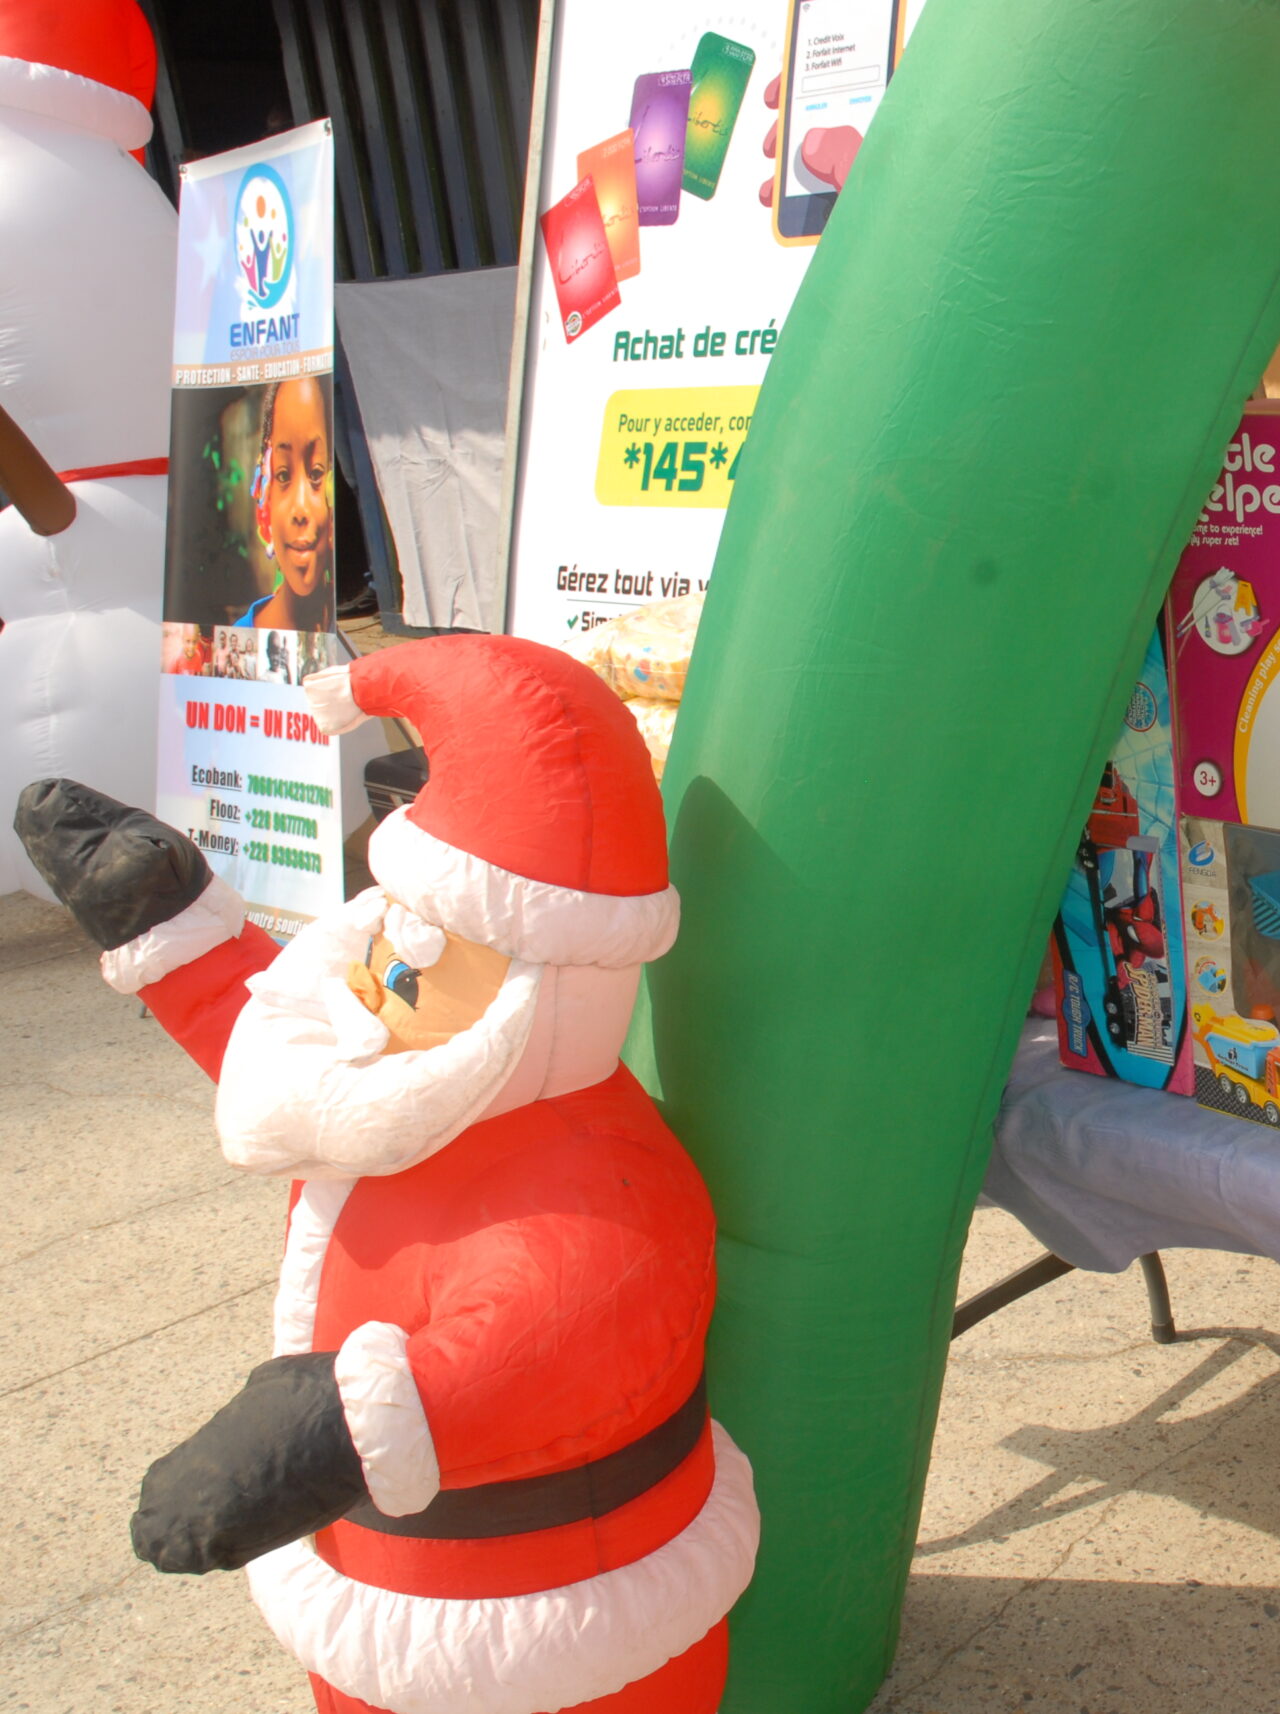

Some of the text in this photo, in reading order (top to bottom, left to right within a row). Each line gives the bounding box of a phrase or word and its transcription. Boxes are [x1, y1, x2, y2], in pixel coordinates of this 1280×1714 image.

[230, 313, 299, 347] ENFANT
[613, 328, 685, 361] Achat
[693, 326, 726, 359] de
[176, 368, 231, 384] PROTECTION
[618, 412, 724, 437] Pour y acceder,
[556, 563, 608, 593] Gérez
[614, 569, 654, 597] tout
[660, 572, 691, 598] via
[1238, 678, 1264, 734] Cleaning
[1259, 652, 1277, 679] play
[186, 701, 209, 729] UN
[214, 703, 246, 734] DON
[264, 709, 282, 738] UN
[191, 764, 242, 790] Ecobank:
[1199, 770, 1217, 788] 3+
[210, 799, 241, 823] Flooz:
